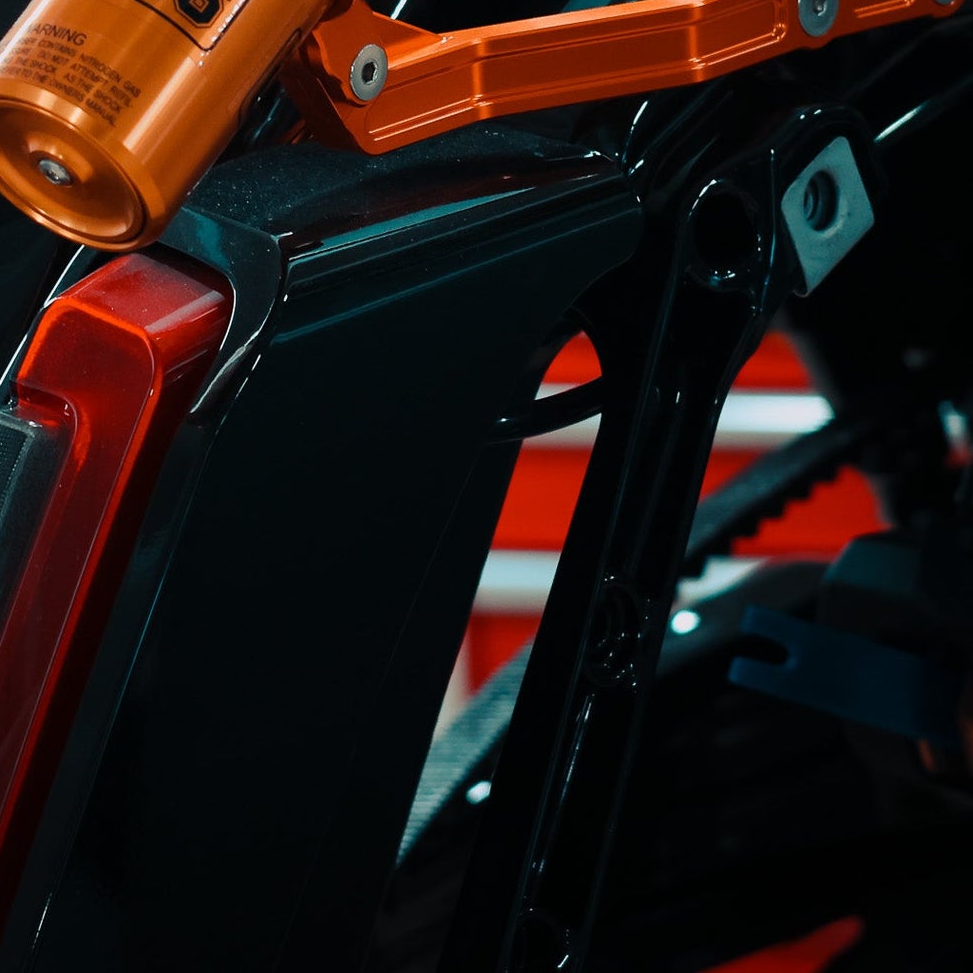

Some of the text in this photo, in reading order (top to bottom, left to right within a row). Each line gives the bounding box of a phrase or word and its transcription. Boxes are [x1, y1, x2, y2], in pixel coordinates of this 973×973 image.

[69, 63, 108, 86] ATTEMPT
[79, 53, 122, 83] NITROGEN
[123, 80, 142, 98] GAS
